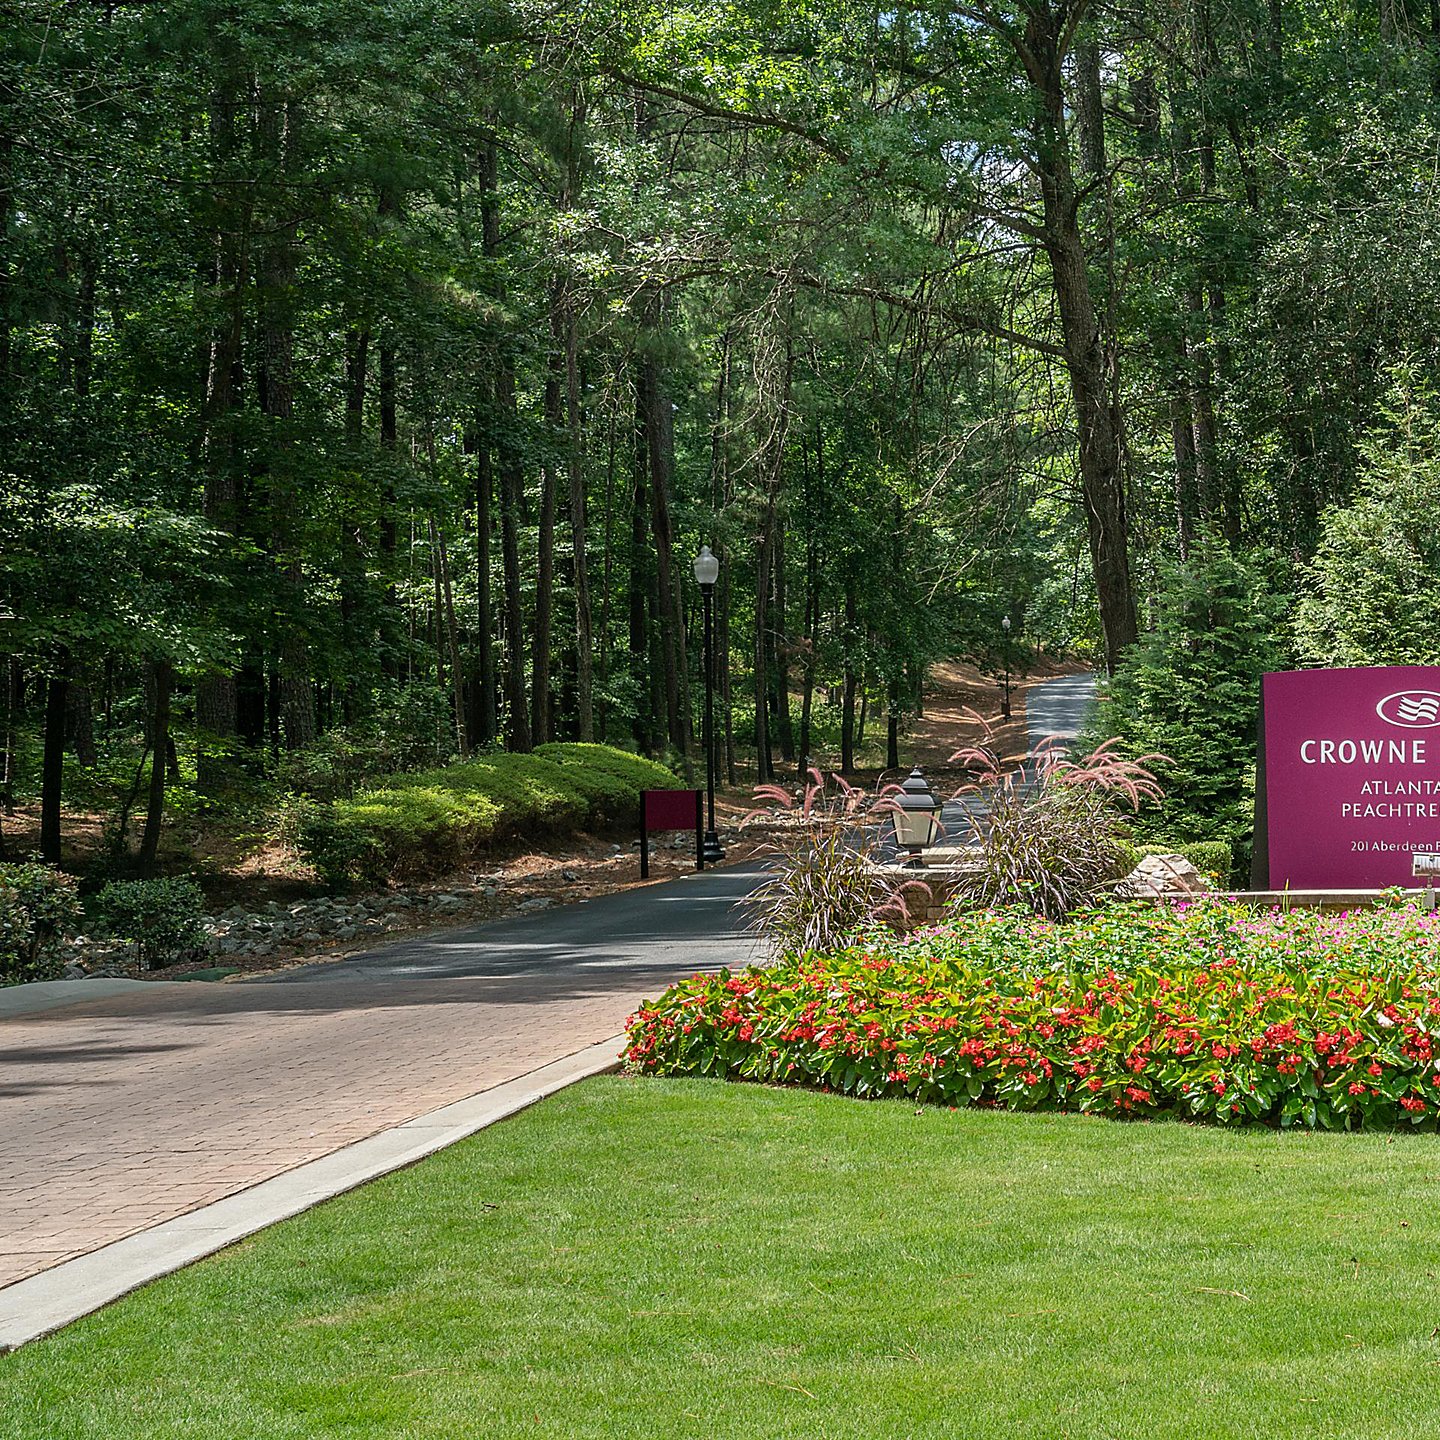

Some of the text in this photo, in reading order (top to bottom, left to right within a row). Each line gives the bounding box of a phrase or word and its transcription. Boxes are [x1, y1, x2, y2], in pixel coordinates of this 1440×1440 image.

[1300, 740, 1426, 764] CROWNE
[1350, 840, 1369, 852] 201
[1371, 840, 1433, 852] Aberdeen
